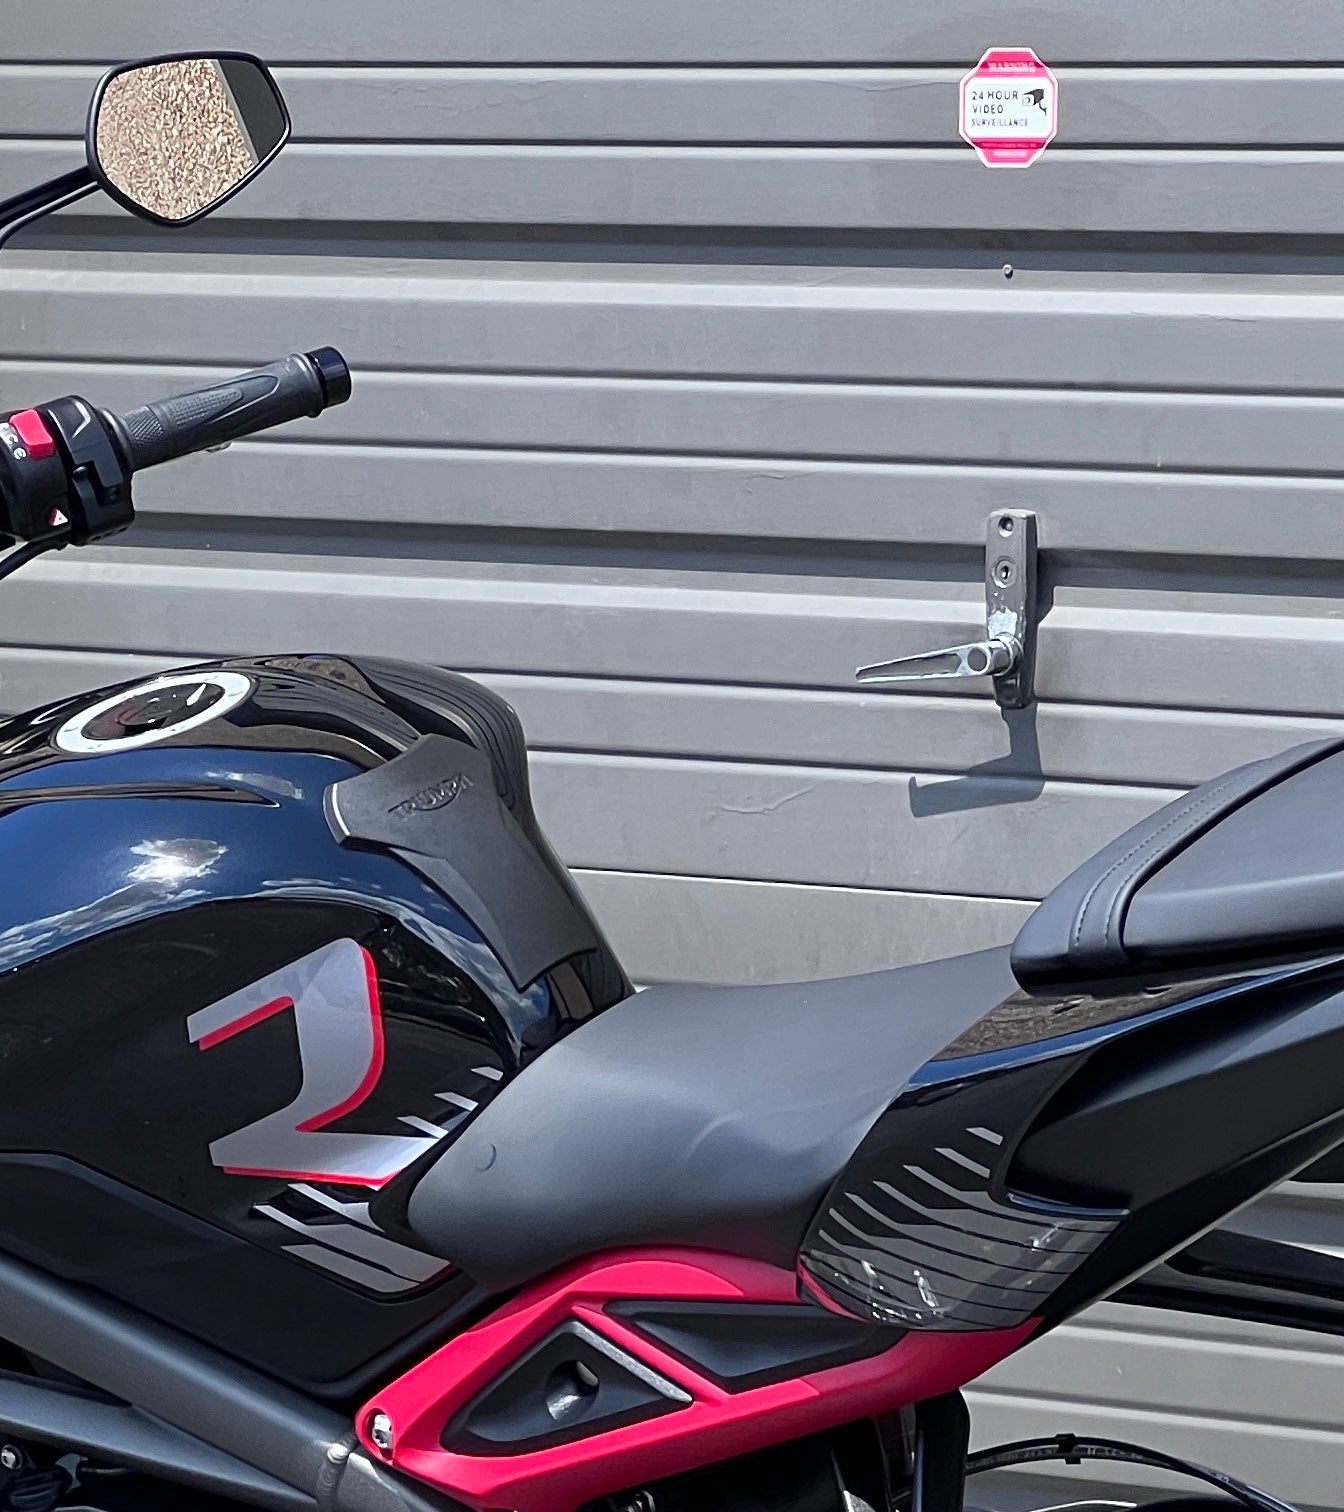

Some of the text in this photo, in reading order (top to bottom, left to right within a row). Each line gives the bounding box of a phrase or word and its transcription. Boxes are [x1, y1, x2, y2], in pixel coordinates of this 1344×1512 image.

[972, 90, 1019, 101] 24 HOUR
[972, 104, 1004, 114] VIDEO
[971, 118, 1029, 127] SURVEILLANCE
